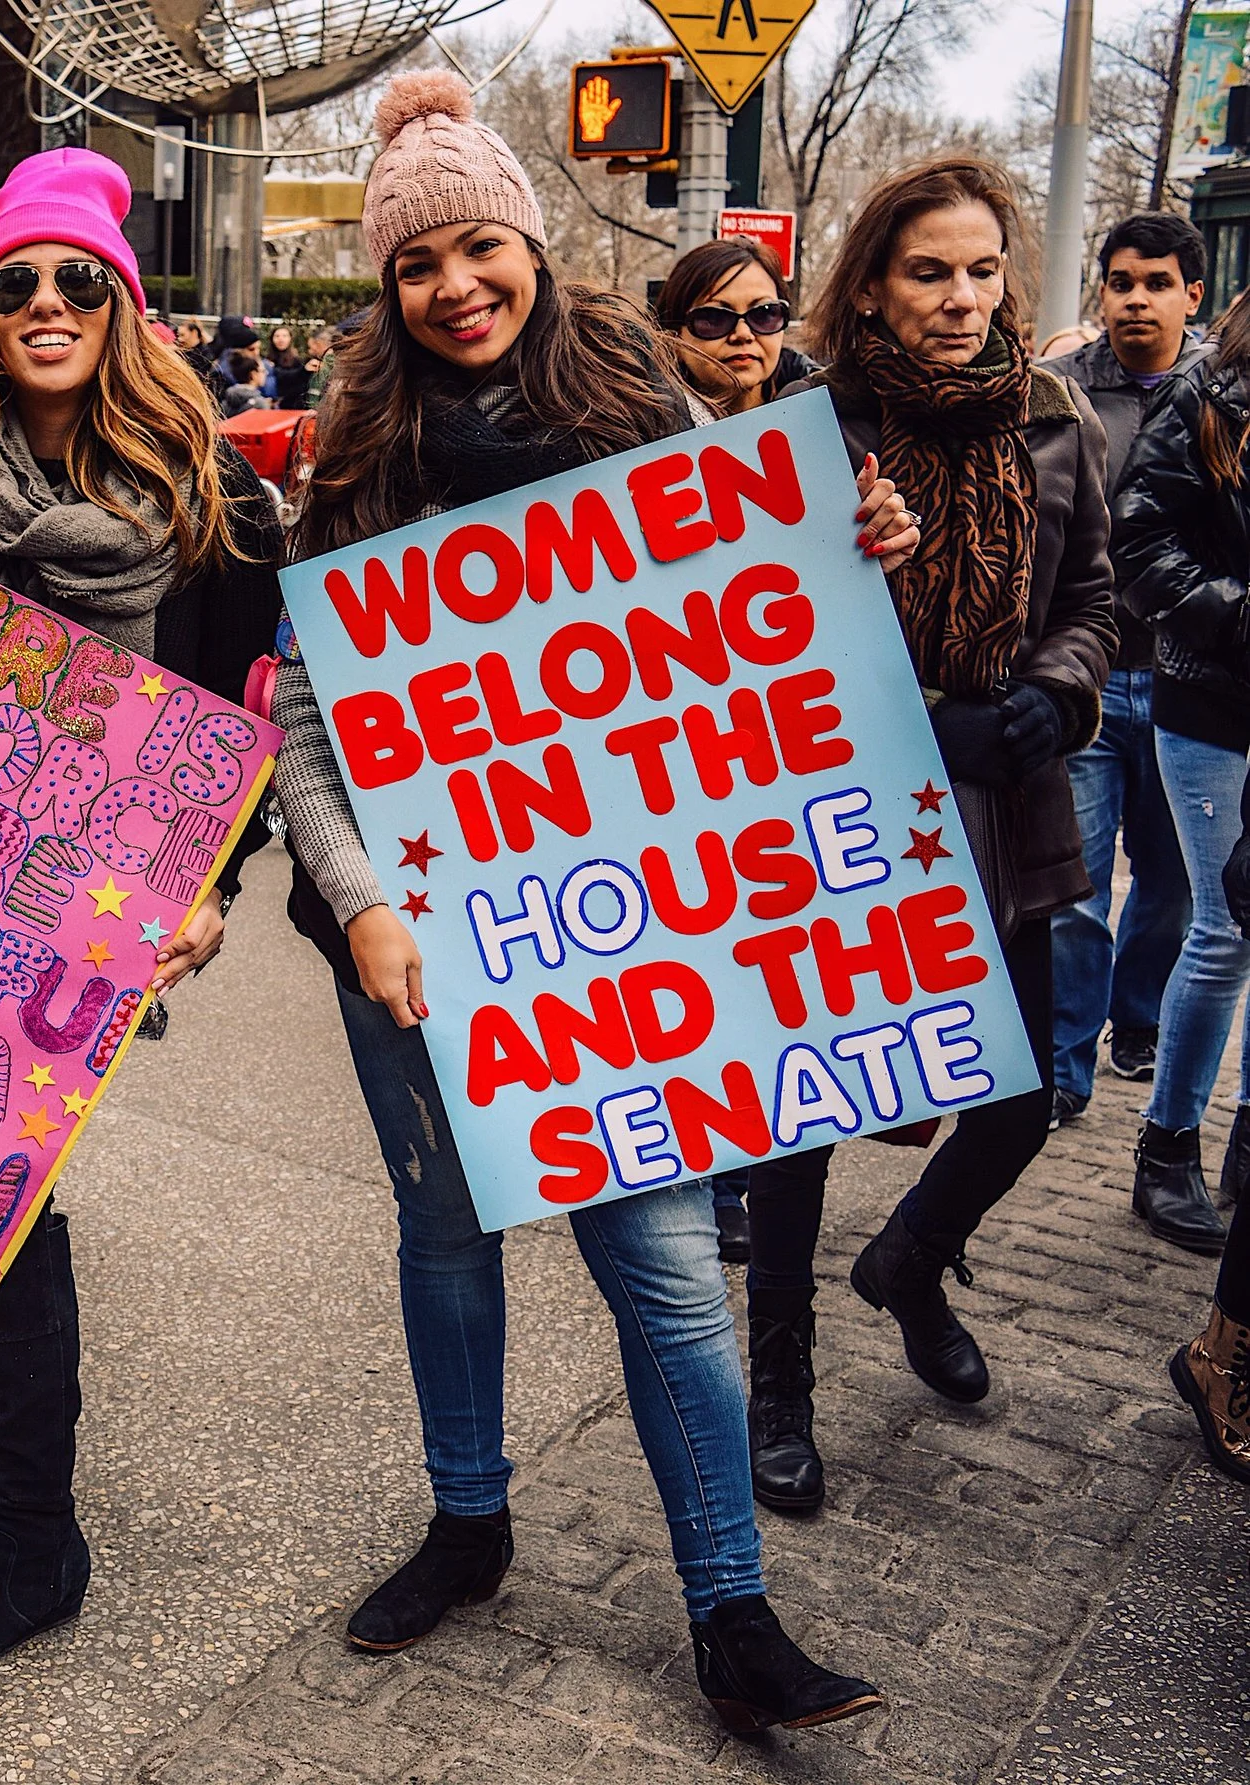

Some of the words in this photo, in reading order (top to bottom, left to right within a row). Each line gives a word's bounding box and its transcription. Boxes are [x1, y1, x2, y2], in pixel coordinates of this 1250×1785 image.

[722, 217, 737, 231] NO
[738, 217, 783, 232] STANDING
[324, 429, 806, 658] WOMEN
[138, 687, 258, 806] IS
[332, 563, 815, 790] BELONG
[447, 742, 592, 862] IN
[605, 668, 855, 816] THE
[465, 786, 892, 984] HOUSE
[466, 960, 716, 1107] AND
[732, 884, 989, 1029] THE
[530, 999, 995, 1204] SENATE
